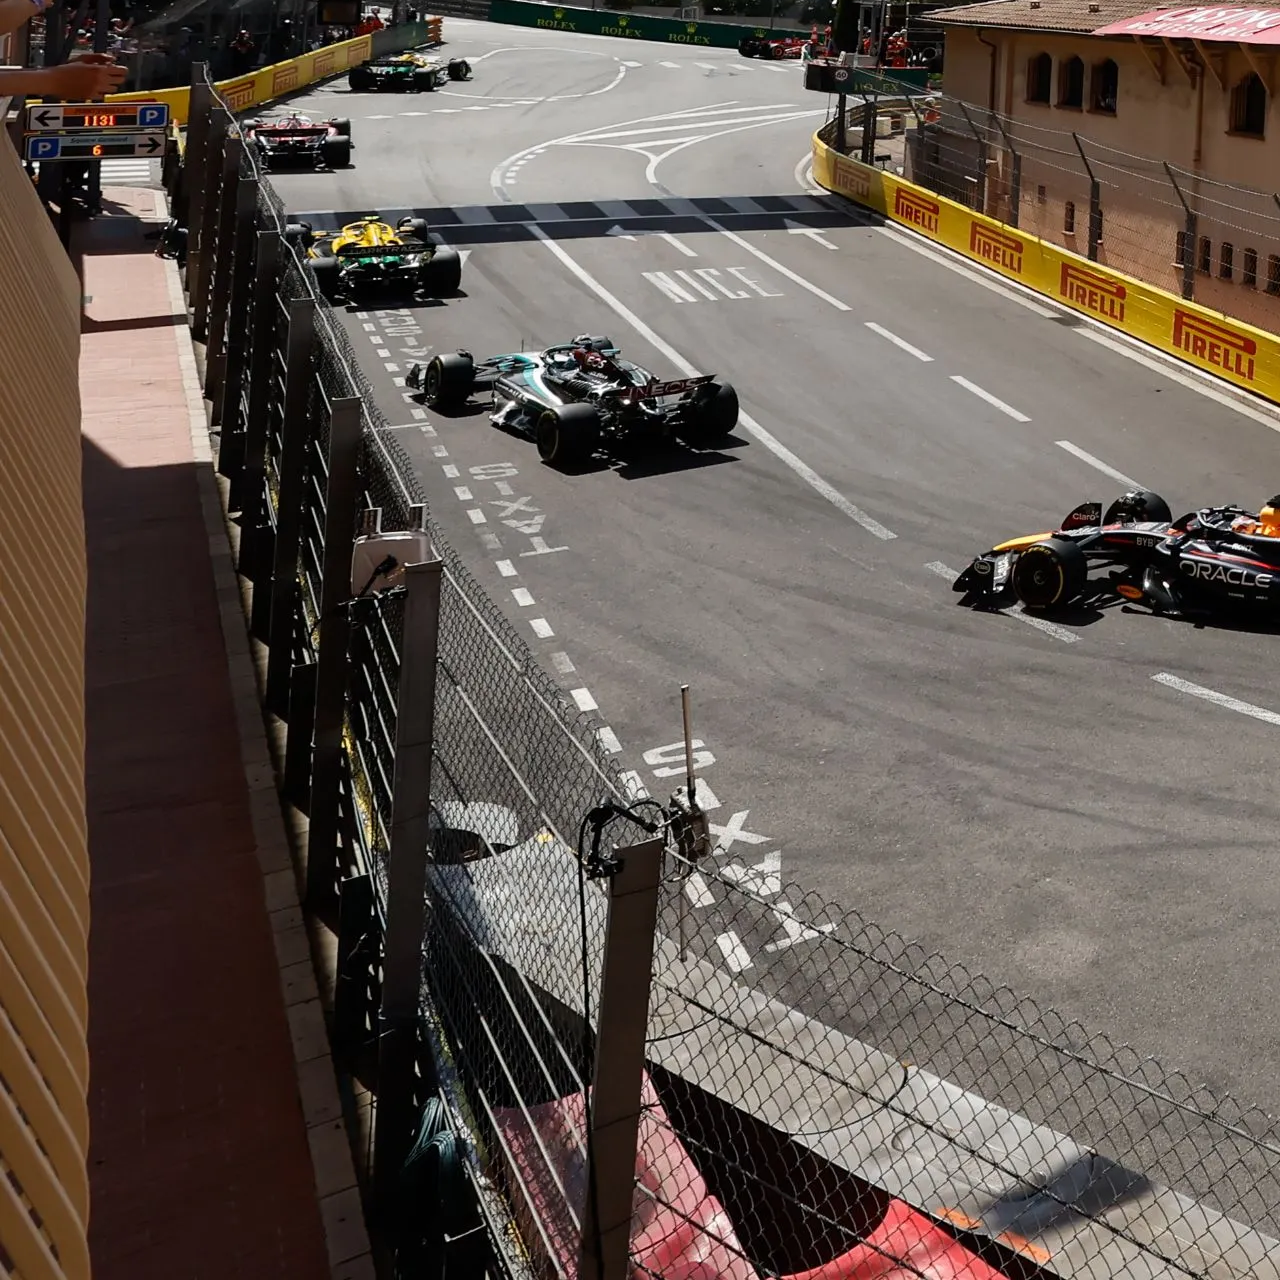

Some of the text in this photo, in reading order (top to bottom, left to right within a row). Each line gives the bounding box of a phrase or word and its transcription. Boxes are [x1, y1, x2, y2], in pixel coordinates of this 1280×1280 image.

[537, 18, 576, 31] ROLEX
[601, 26, 642, 37] ROLEX
[669, 33, 711, 44] ROLEX
[272, 66, 299, 95] PIRELLI
[83, 115, 115, 126] 1131
[145, 110, 159, 122] P
[38, 142, 52, 154] P
[92, 145, 102, 156] 6
[833, 158, 871, 199] PIRELLI
[895, 186, 939, 233] PIRELLI
[350, 244, 424, 254] DARKTRACE
[970, 220, 1024, 274] PIRELLI
[641, 267, 785, 303] NICE
[1060, 261, 1126, 322] PIRELLI
[1173, 308, 1256, 381] PIRELLI
[627, 378, 700, 403] INEOS
[1072, 511, 1096, 521] Claro
[1179, 560, 1273, 588] ORACLE
